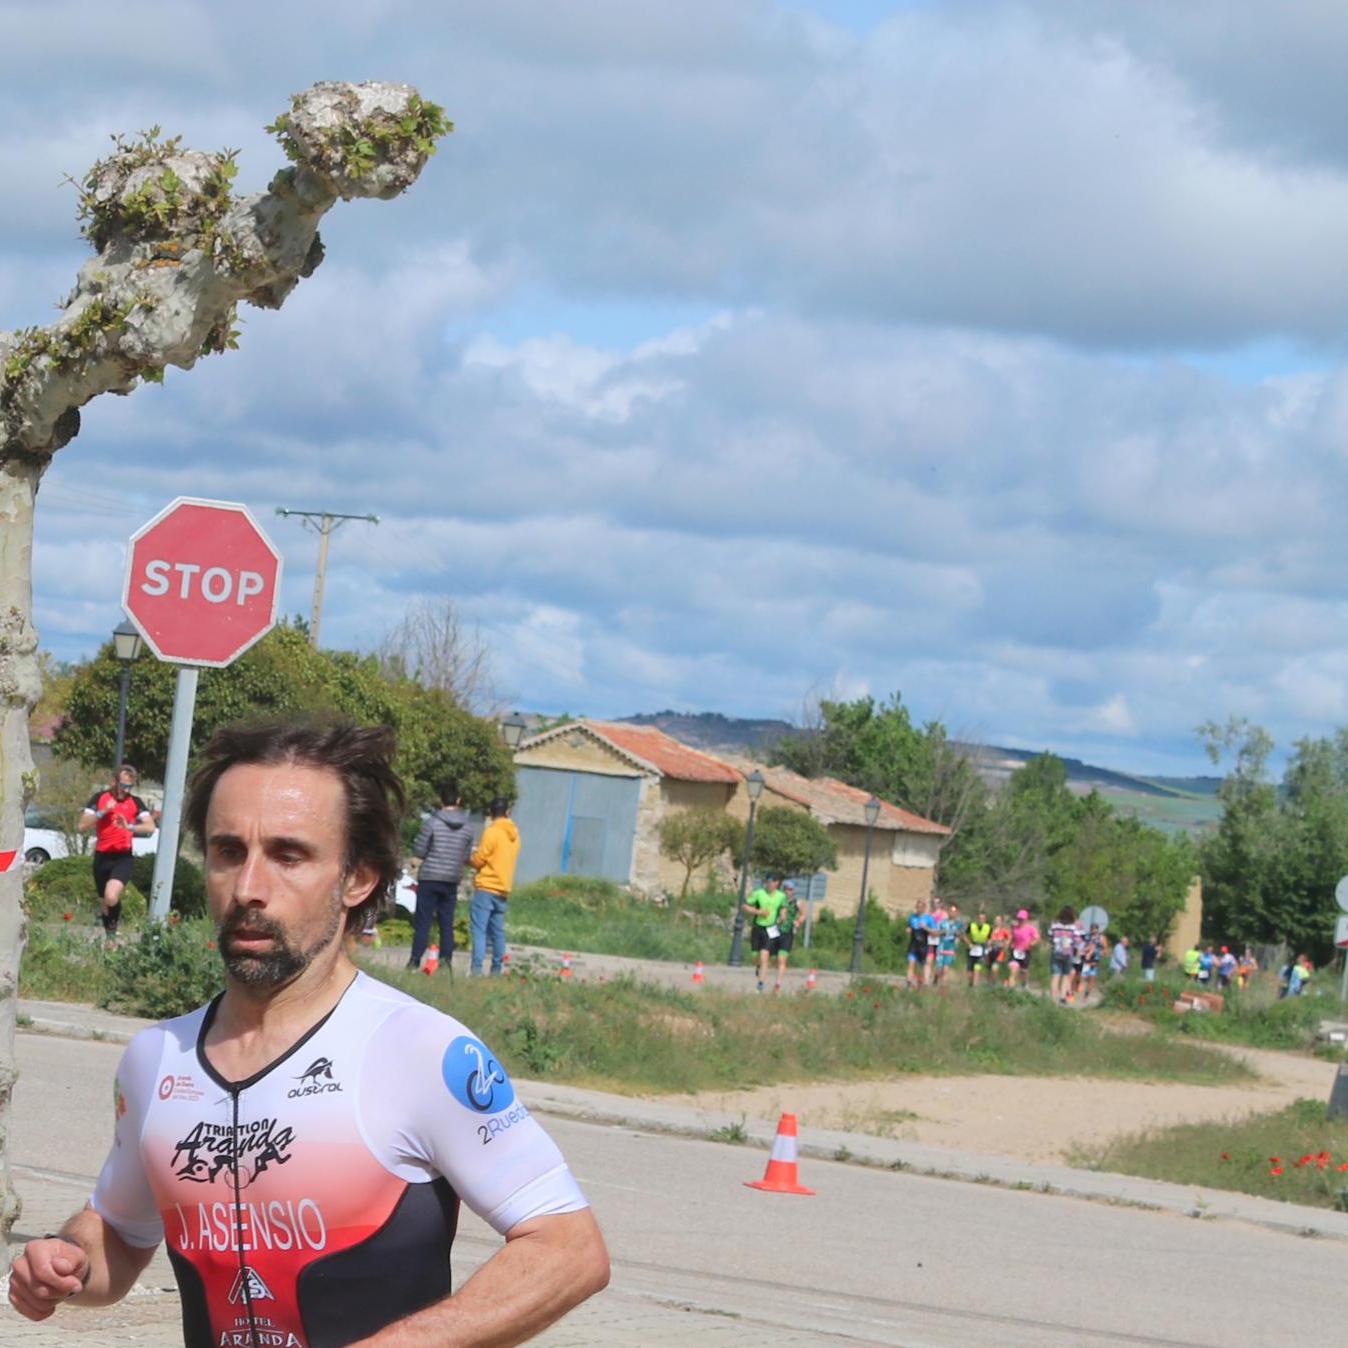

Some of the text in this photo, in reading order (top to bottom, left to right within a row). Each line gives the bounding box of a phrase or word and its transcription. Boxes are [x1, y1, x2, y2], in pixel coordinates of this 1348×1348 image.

[141, 559, 265, 606] STOP
[171, 1118, 296, 1168] Aranda
[198, 1198, 326, 1252] ASENSIO
[219, 1331, 302, 1348] ARANDA
